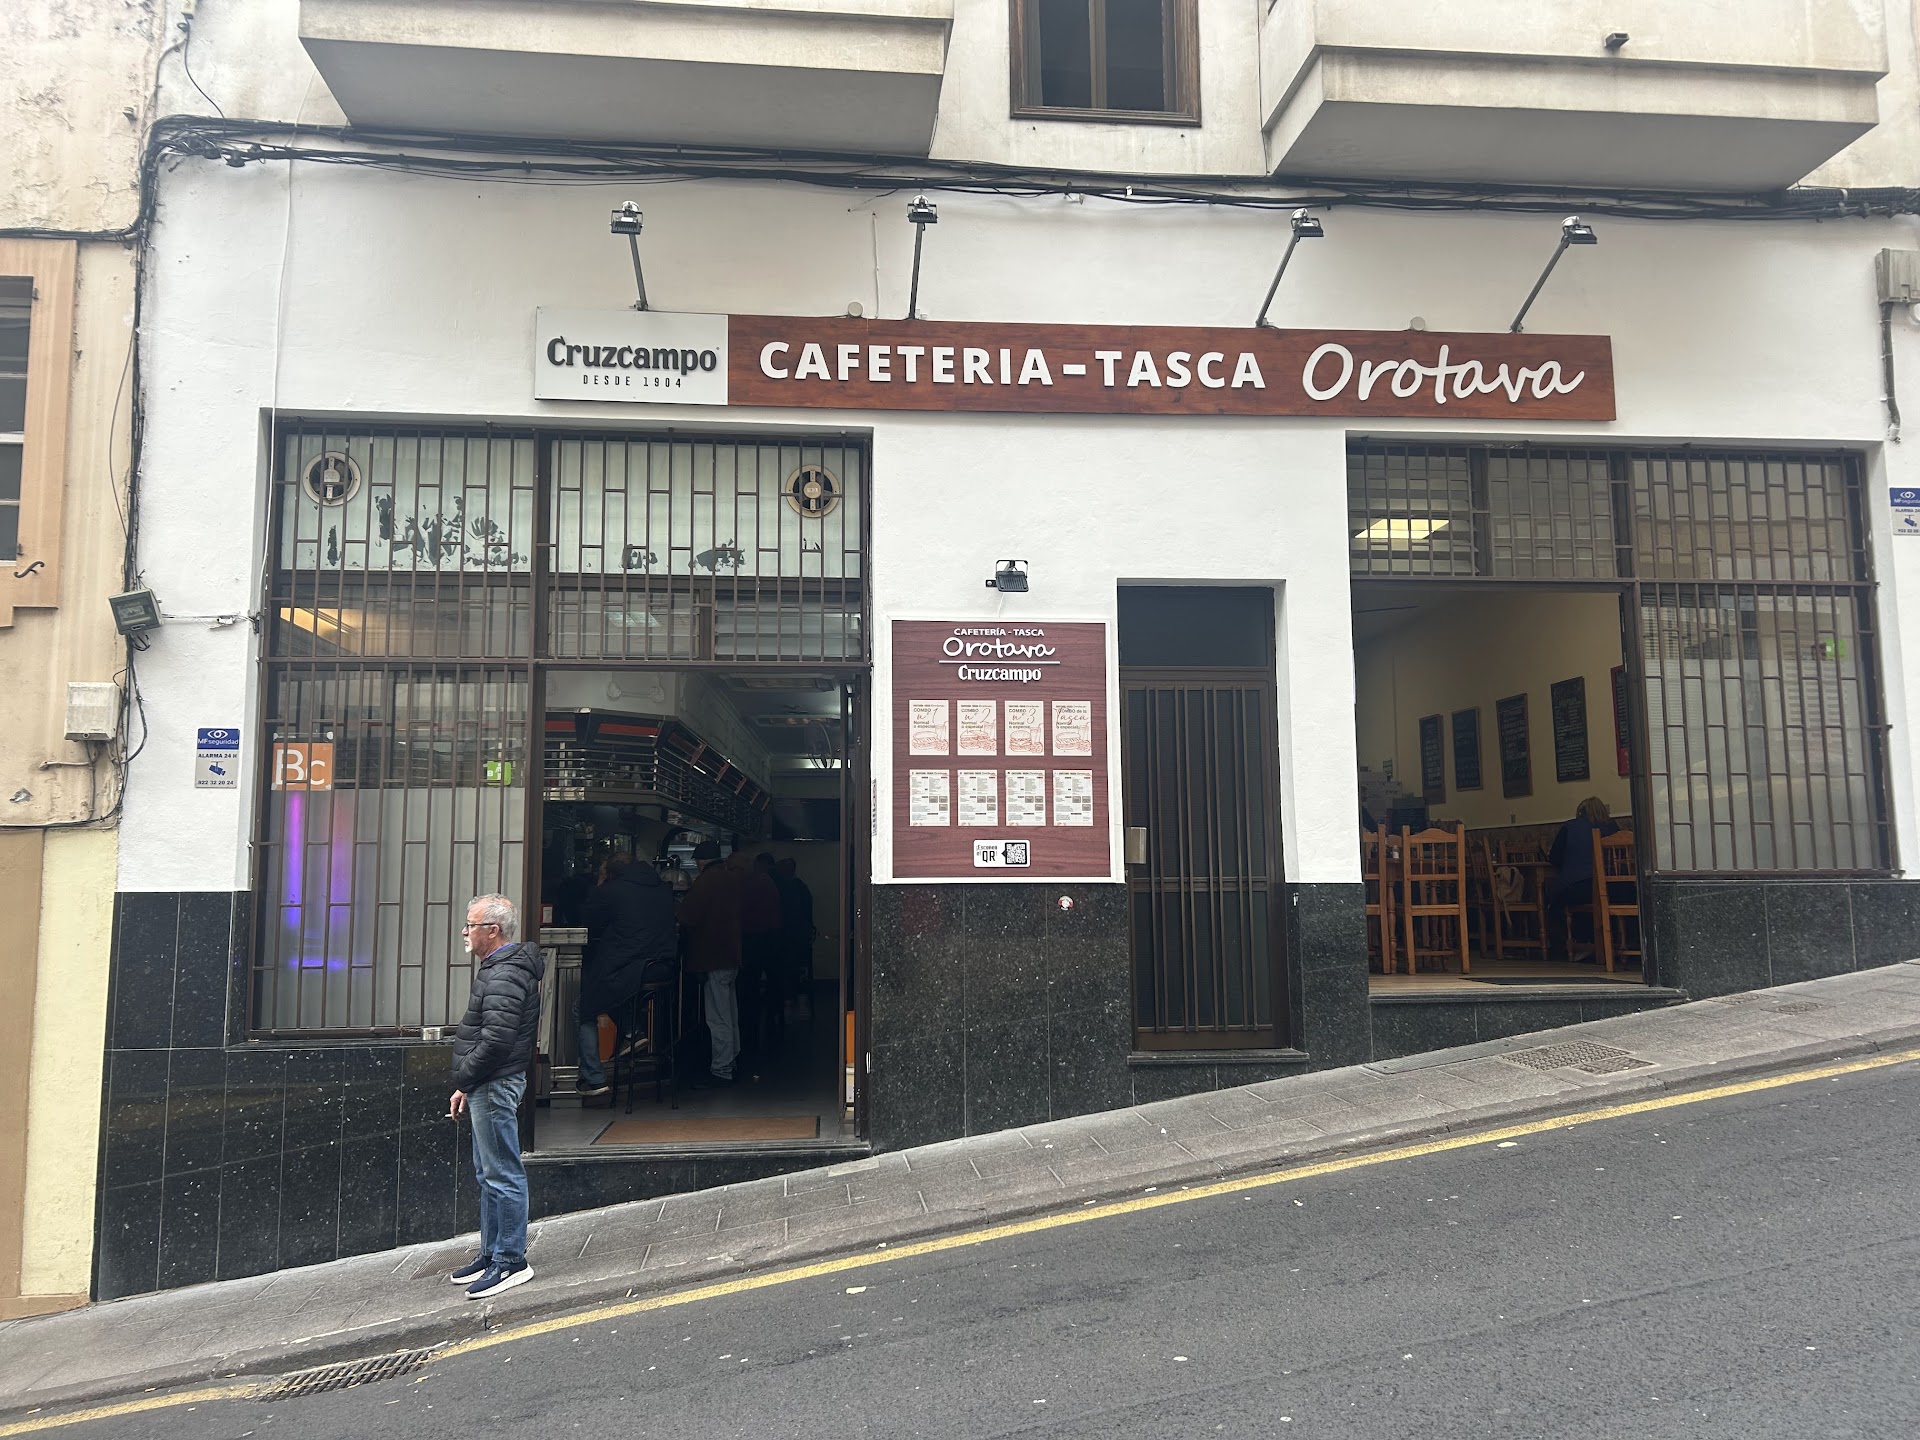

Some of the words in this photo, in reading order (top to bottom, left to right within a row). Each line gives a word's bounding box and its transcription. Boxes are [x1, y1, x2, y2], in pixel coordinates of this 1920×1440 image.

[547, 336, 717, 376] Cruzcampo
[583, 374, 631, 387] DESDE
[643, 376, 682, 388] 1904
[759, 341, 1054, 386] CAFETERIA
[1095, 350, 1267, 389] TASCA
[1302, 343, 1585, 404] Orotava
[953, 627, 1006, 636] CAFETERÍA
[1013, 628, 1045, 636] TASCA
[943, 637, 1055, 658] Orotava
[957, 664, 1042, 683] Cruzcampo
